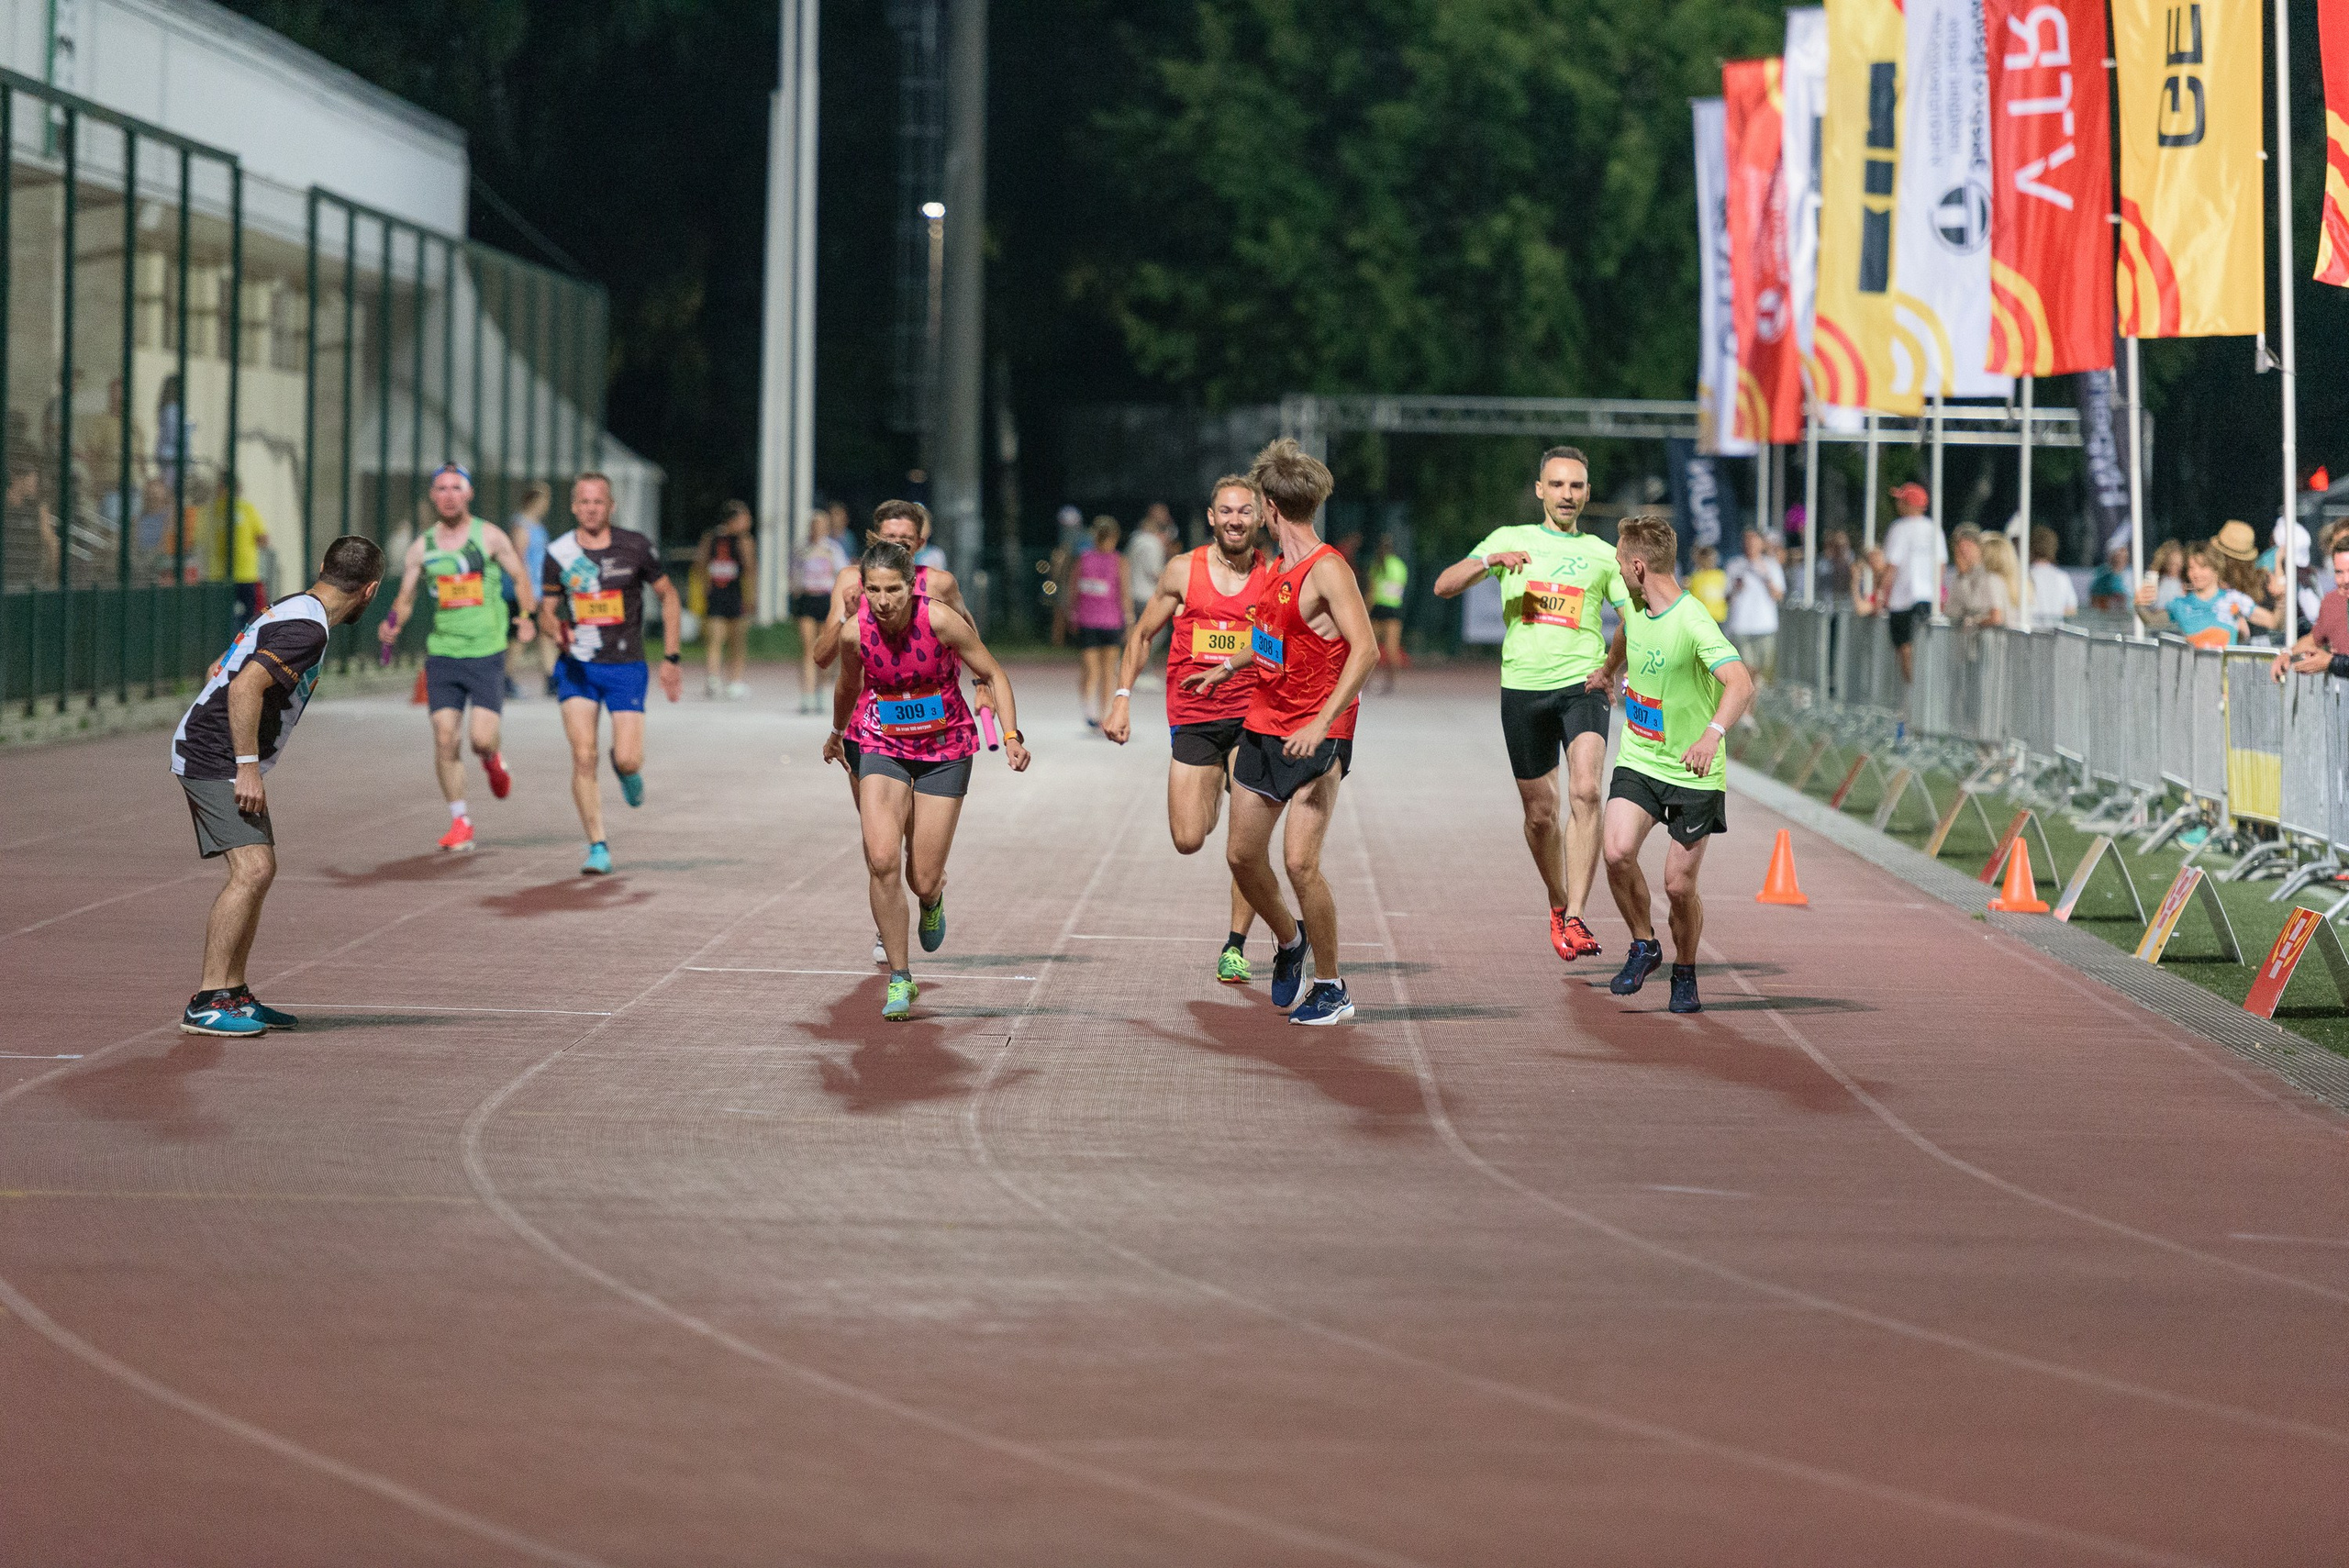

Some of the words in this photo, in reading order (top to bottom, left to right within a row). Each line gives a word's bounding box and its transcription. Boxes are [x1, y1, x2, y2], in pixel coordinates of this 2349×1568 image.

[1570, 606, 1575, 614] 2
[1208, 634, 1236, 651] 308
[1258, 635, 1274, 656] 308
[895, 703, 925, 721] 309
[930, 706, 937, 716] 3
[1632, 705, 1649, 724] 307
[1653, 718, 1658, 728] 3
